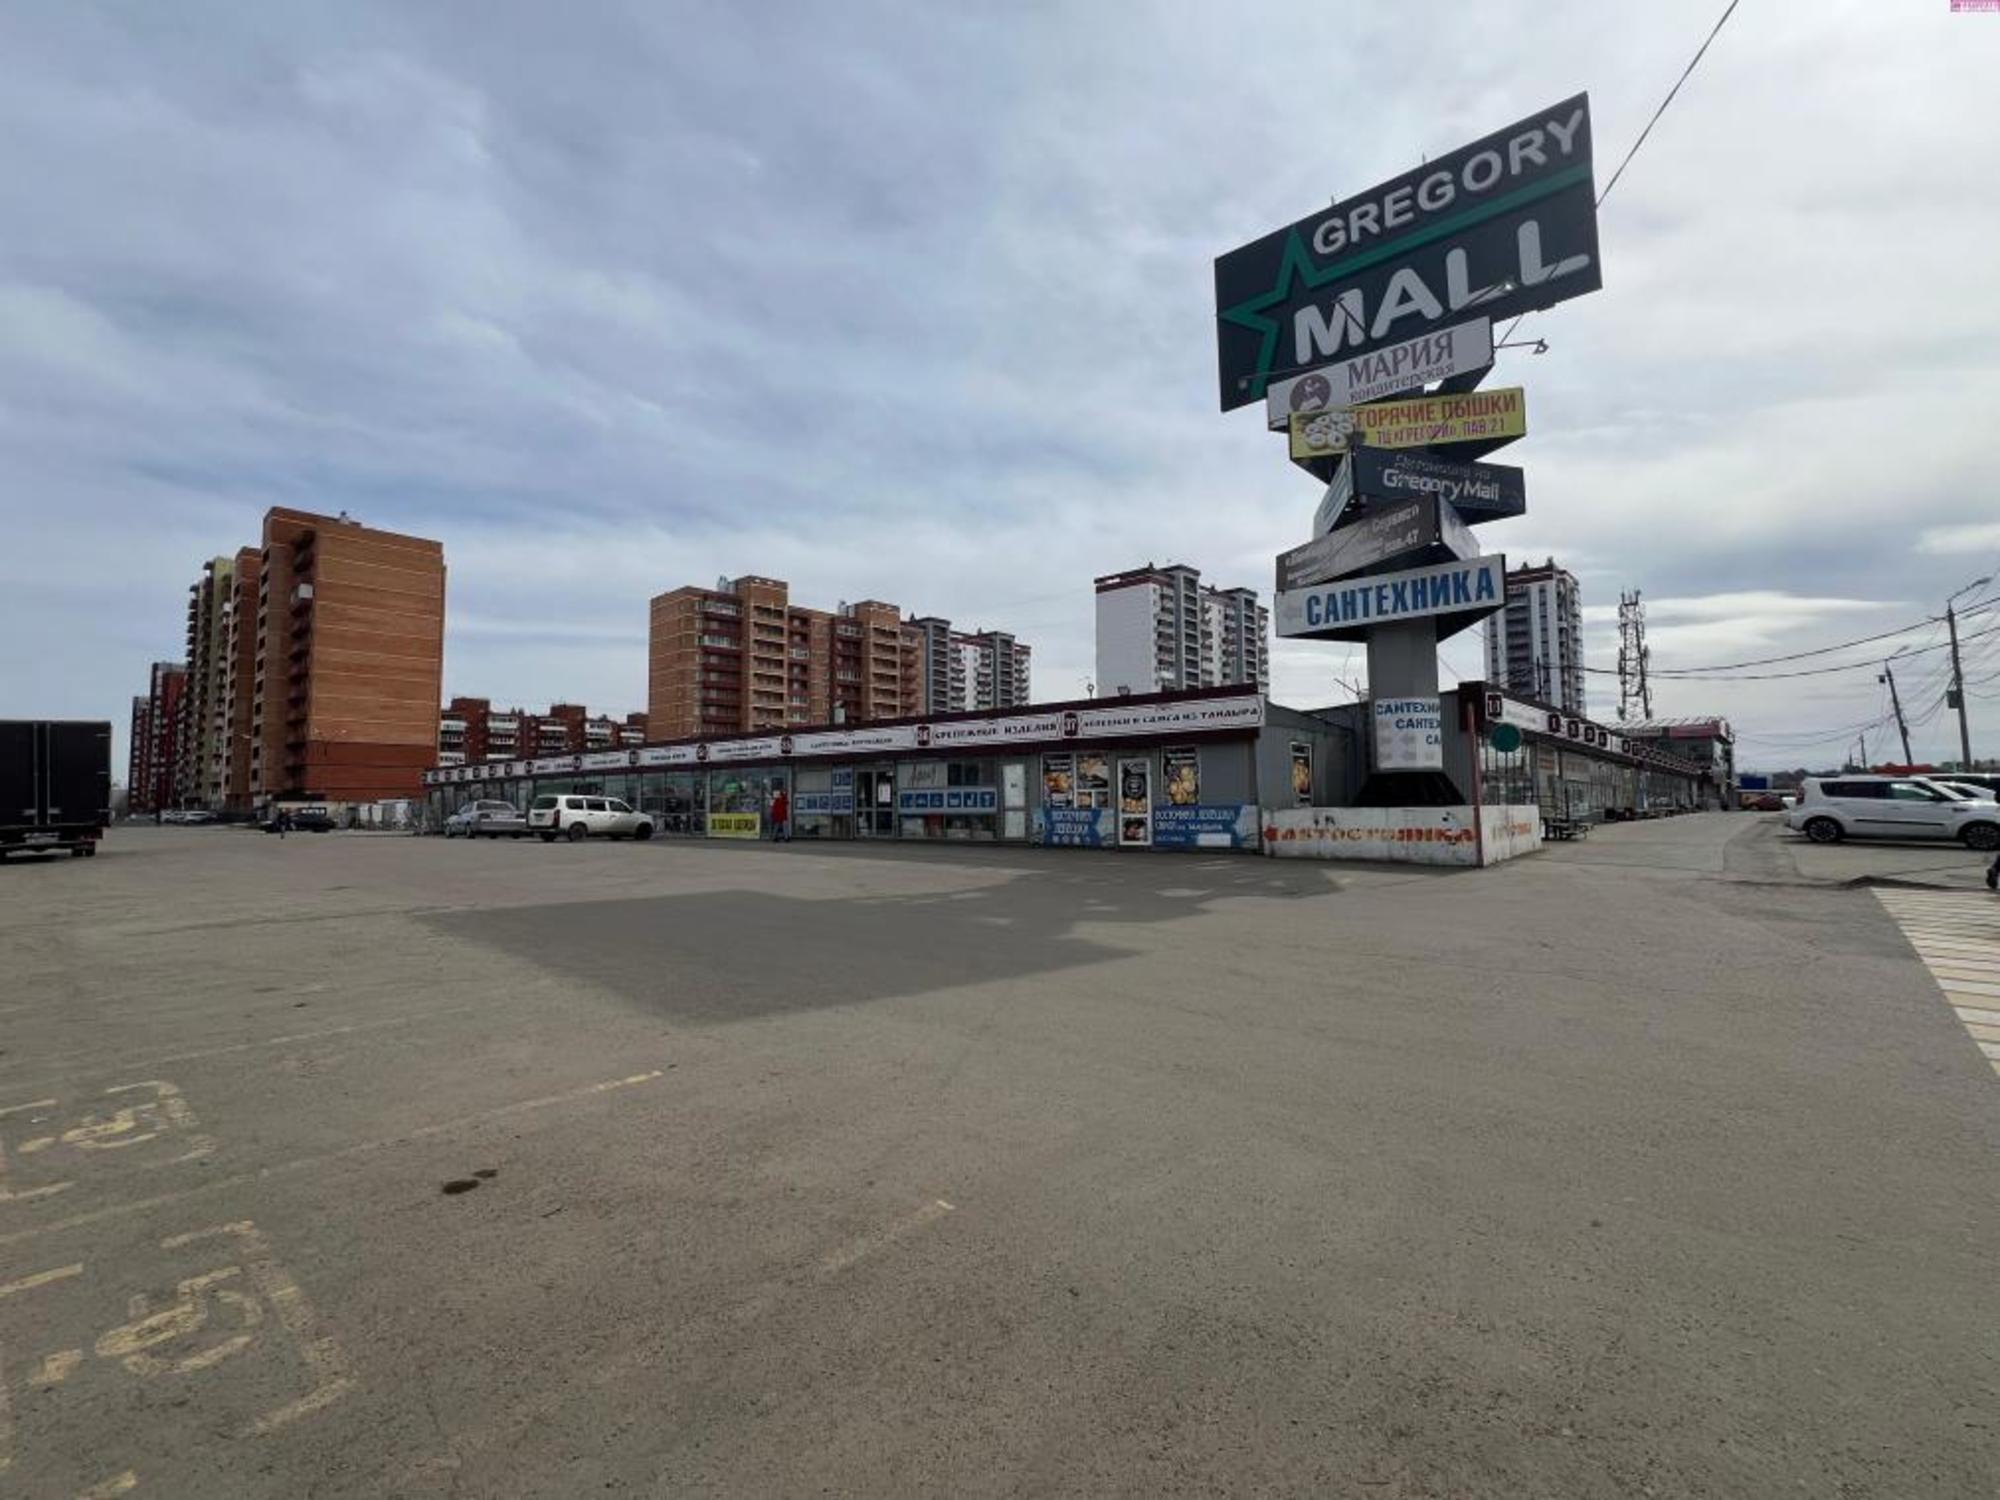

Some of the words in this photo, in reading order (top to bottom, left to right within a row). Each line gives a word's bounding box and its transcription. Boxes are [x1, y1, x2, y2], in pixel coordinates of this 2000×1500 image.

[1313, 108, 1584, 255] GREGORY
[1294, 219, 1591, 365] MALL
[1347, 331, 1454, 389] МАРИЯ
[1356, 402, 1436, 428] ГОРЯЧИЕ
[1442, 393, 1516, 420] ПЫШКИ
[1306, 566, 1495, 627] САНТЕХНИКА
